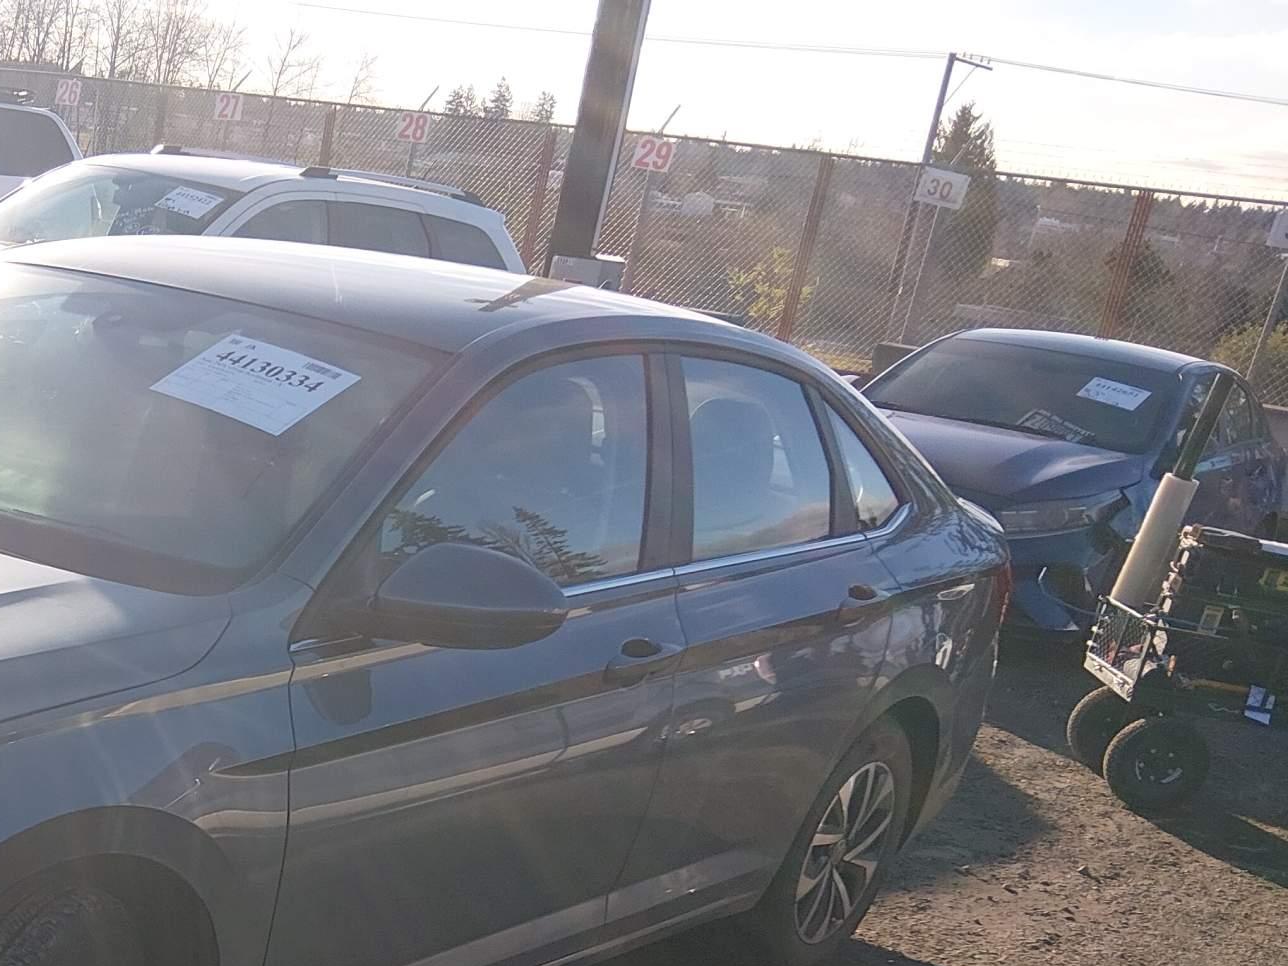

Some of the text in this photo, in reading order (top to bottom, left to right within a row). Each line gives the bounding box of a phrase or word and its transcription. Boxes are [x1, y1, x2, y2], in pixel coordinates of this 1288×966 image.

[60, 79, 79, 104] 26
[217, 94, 239, 118] 27
[397, 113, 428, 141] 28
[633, 138, 673, 170] 29
[927, 178, 953, 200] 30
[216, 350, 325, 393] 44130334
